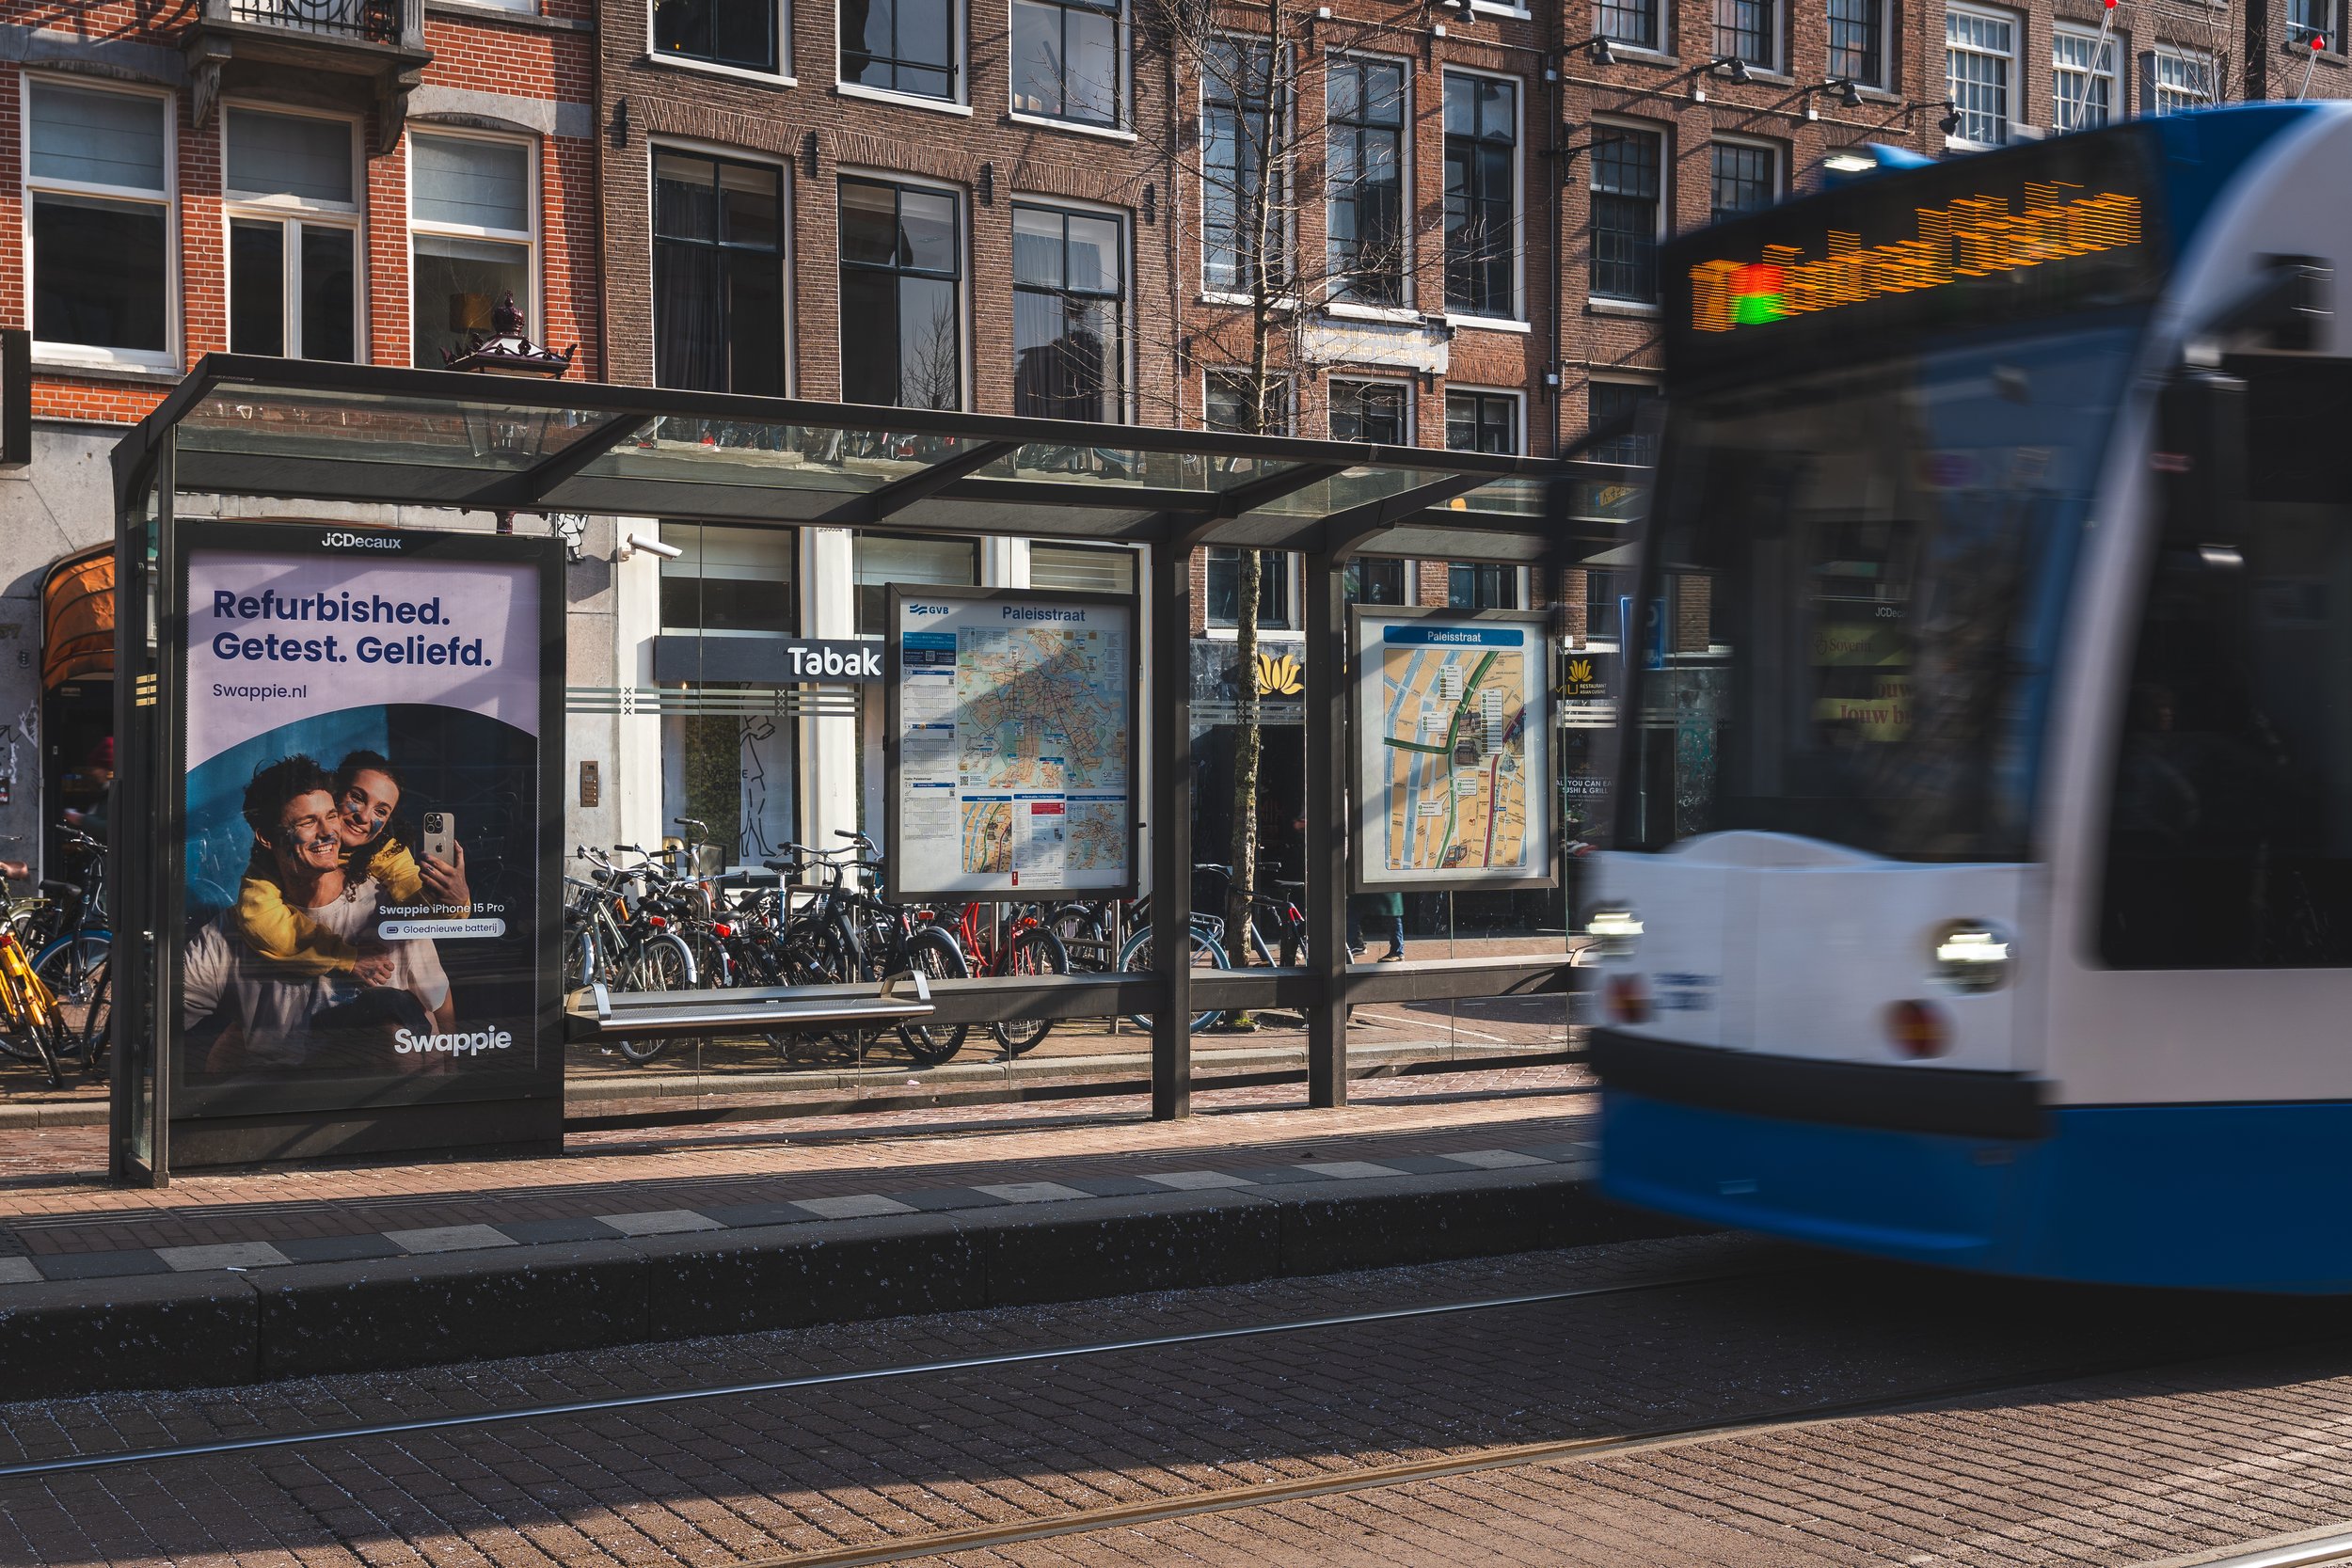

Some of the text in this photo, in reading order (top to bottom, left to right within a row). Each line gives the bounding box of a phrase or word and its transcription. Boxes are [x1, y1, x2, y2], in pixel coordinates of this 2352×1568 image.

[321, 531, 402, 549] JCDecaux
[213, 589, 451, 626] Refurbished.
[929, 606, 949, 615] GVB
[1002, 606, 1087, 624] Paleisstraat
[1427, 630, 1482, 643] Paleisstraat
[213, 631, 493, 668] Getest. Geliefd.
[787, 645, 882, 677] Tabak
[213, 682, 308, 704] Swappie.nl
[379, 900, 505, 917] Swappie iPhone 15 Pro
[403, 922, 499, 937] Gloednieuwe batterij
[394, 1023, 513, 1057] Swappie
